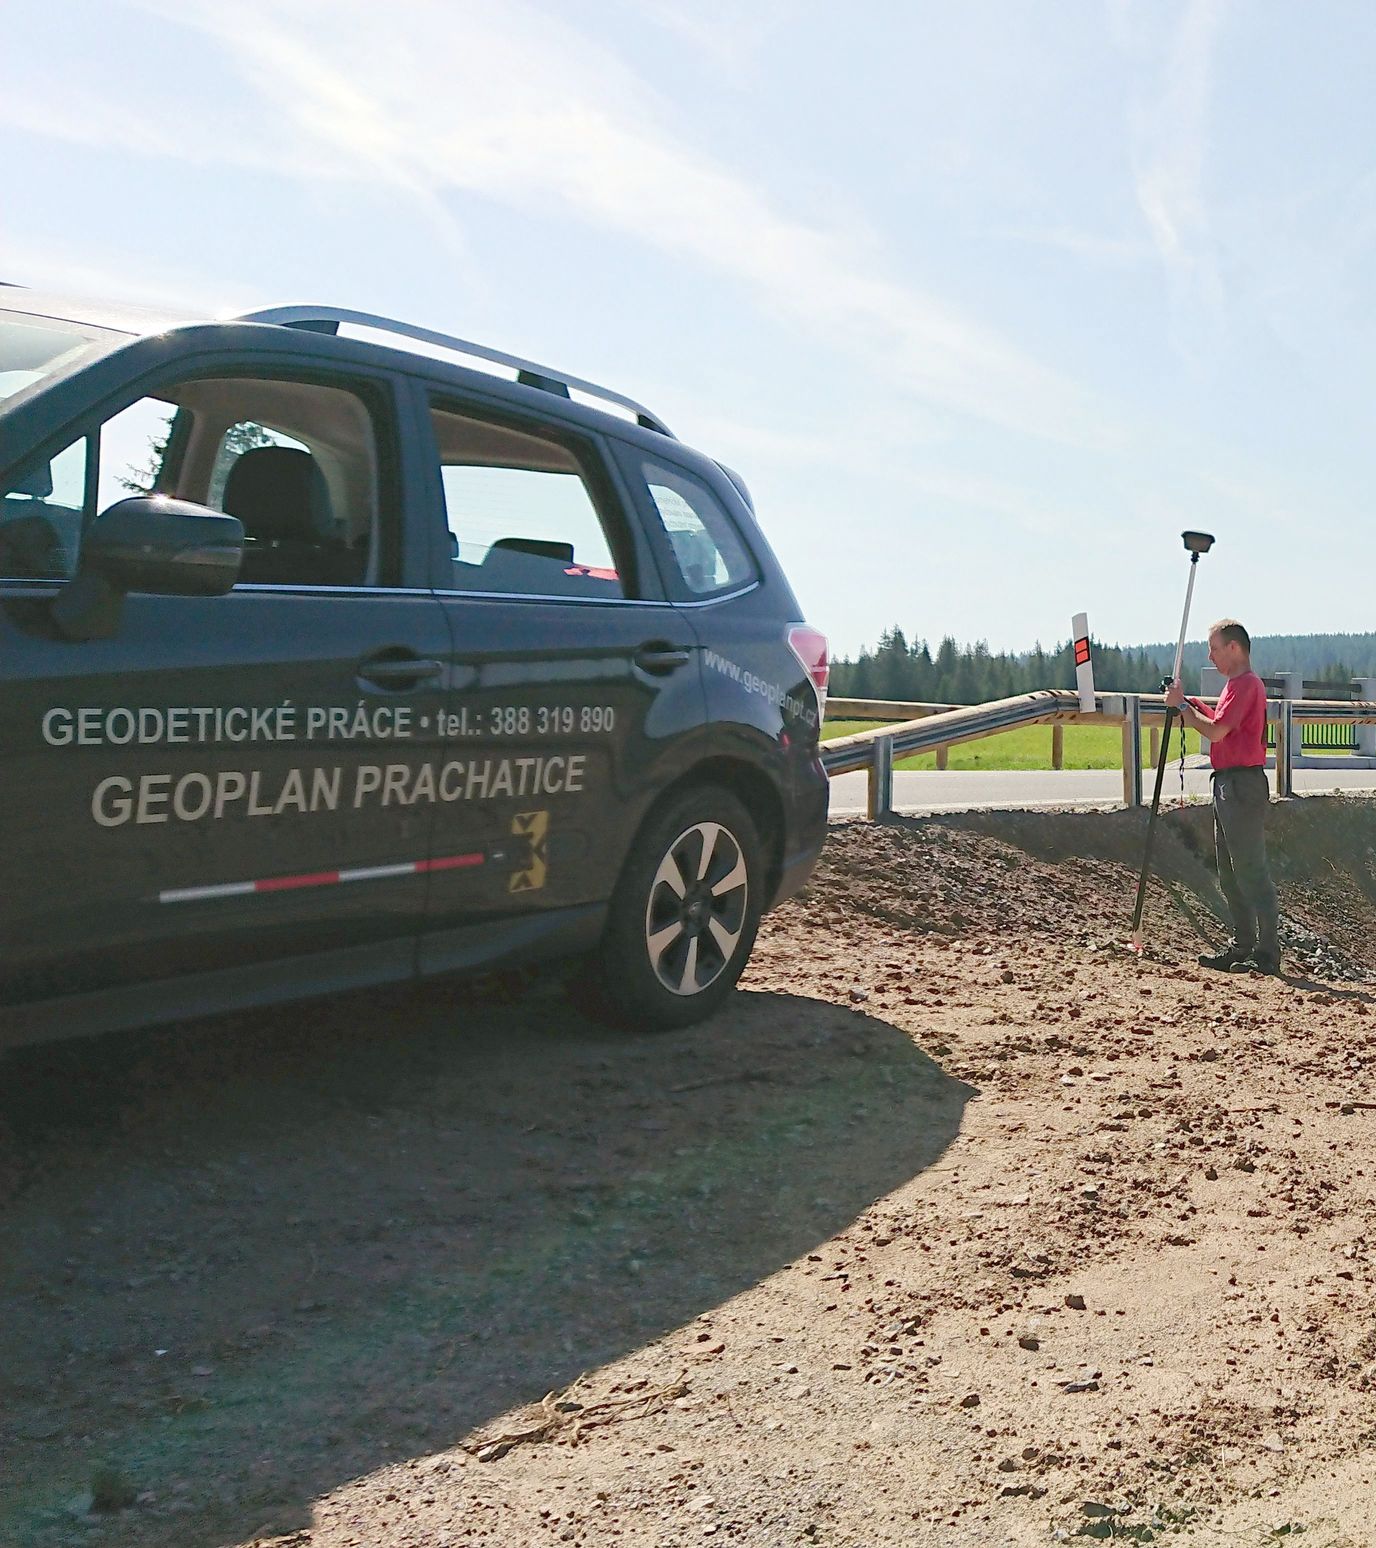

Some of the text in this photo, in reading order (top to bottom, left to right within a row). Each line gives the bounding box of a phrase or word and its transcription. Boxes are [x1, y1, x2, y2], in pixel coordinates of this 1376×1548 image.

[41, 699, 615, 746] GEODETICKÉ PRÁCE tel.: 388 319 890
[91, 755, 586, 827] GEOPLAN PRACHATICE
